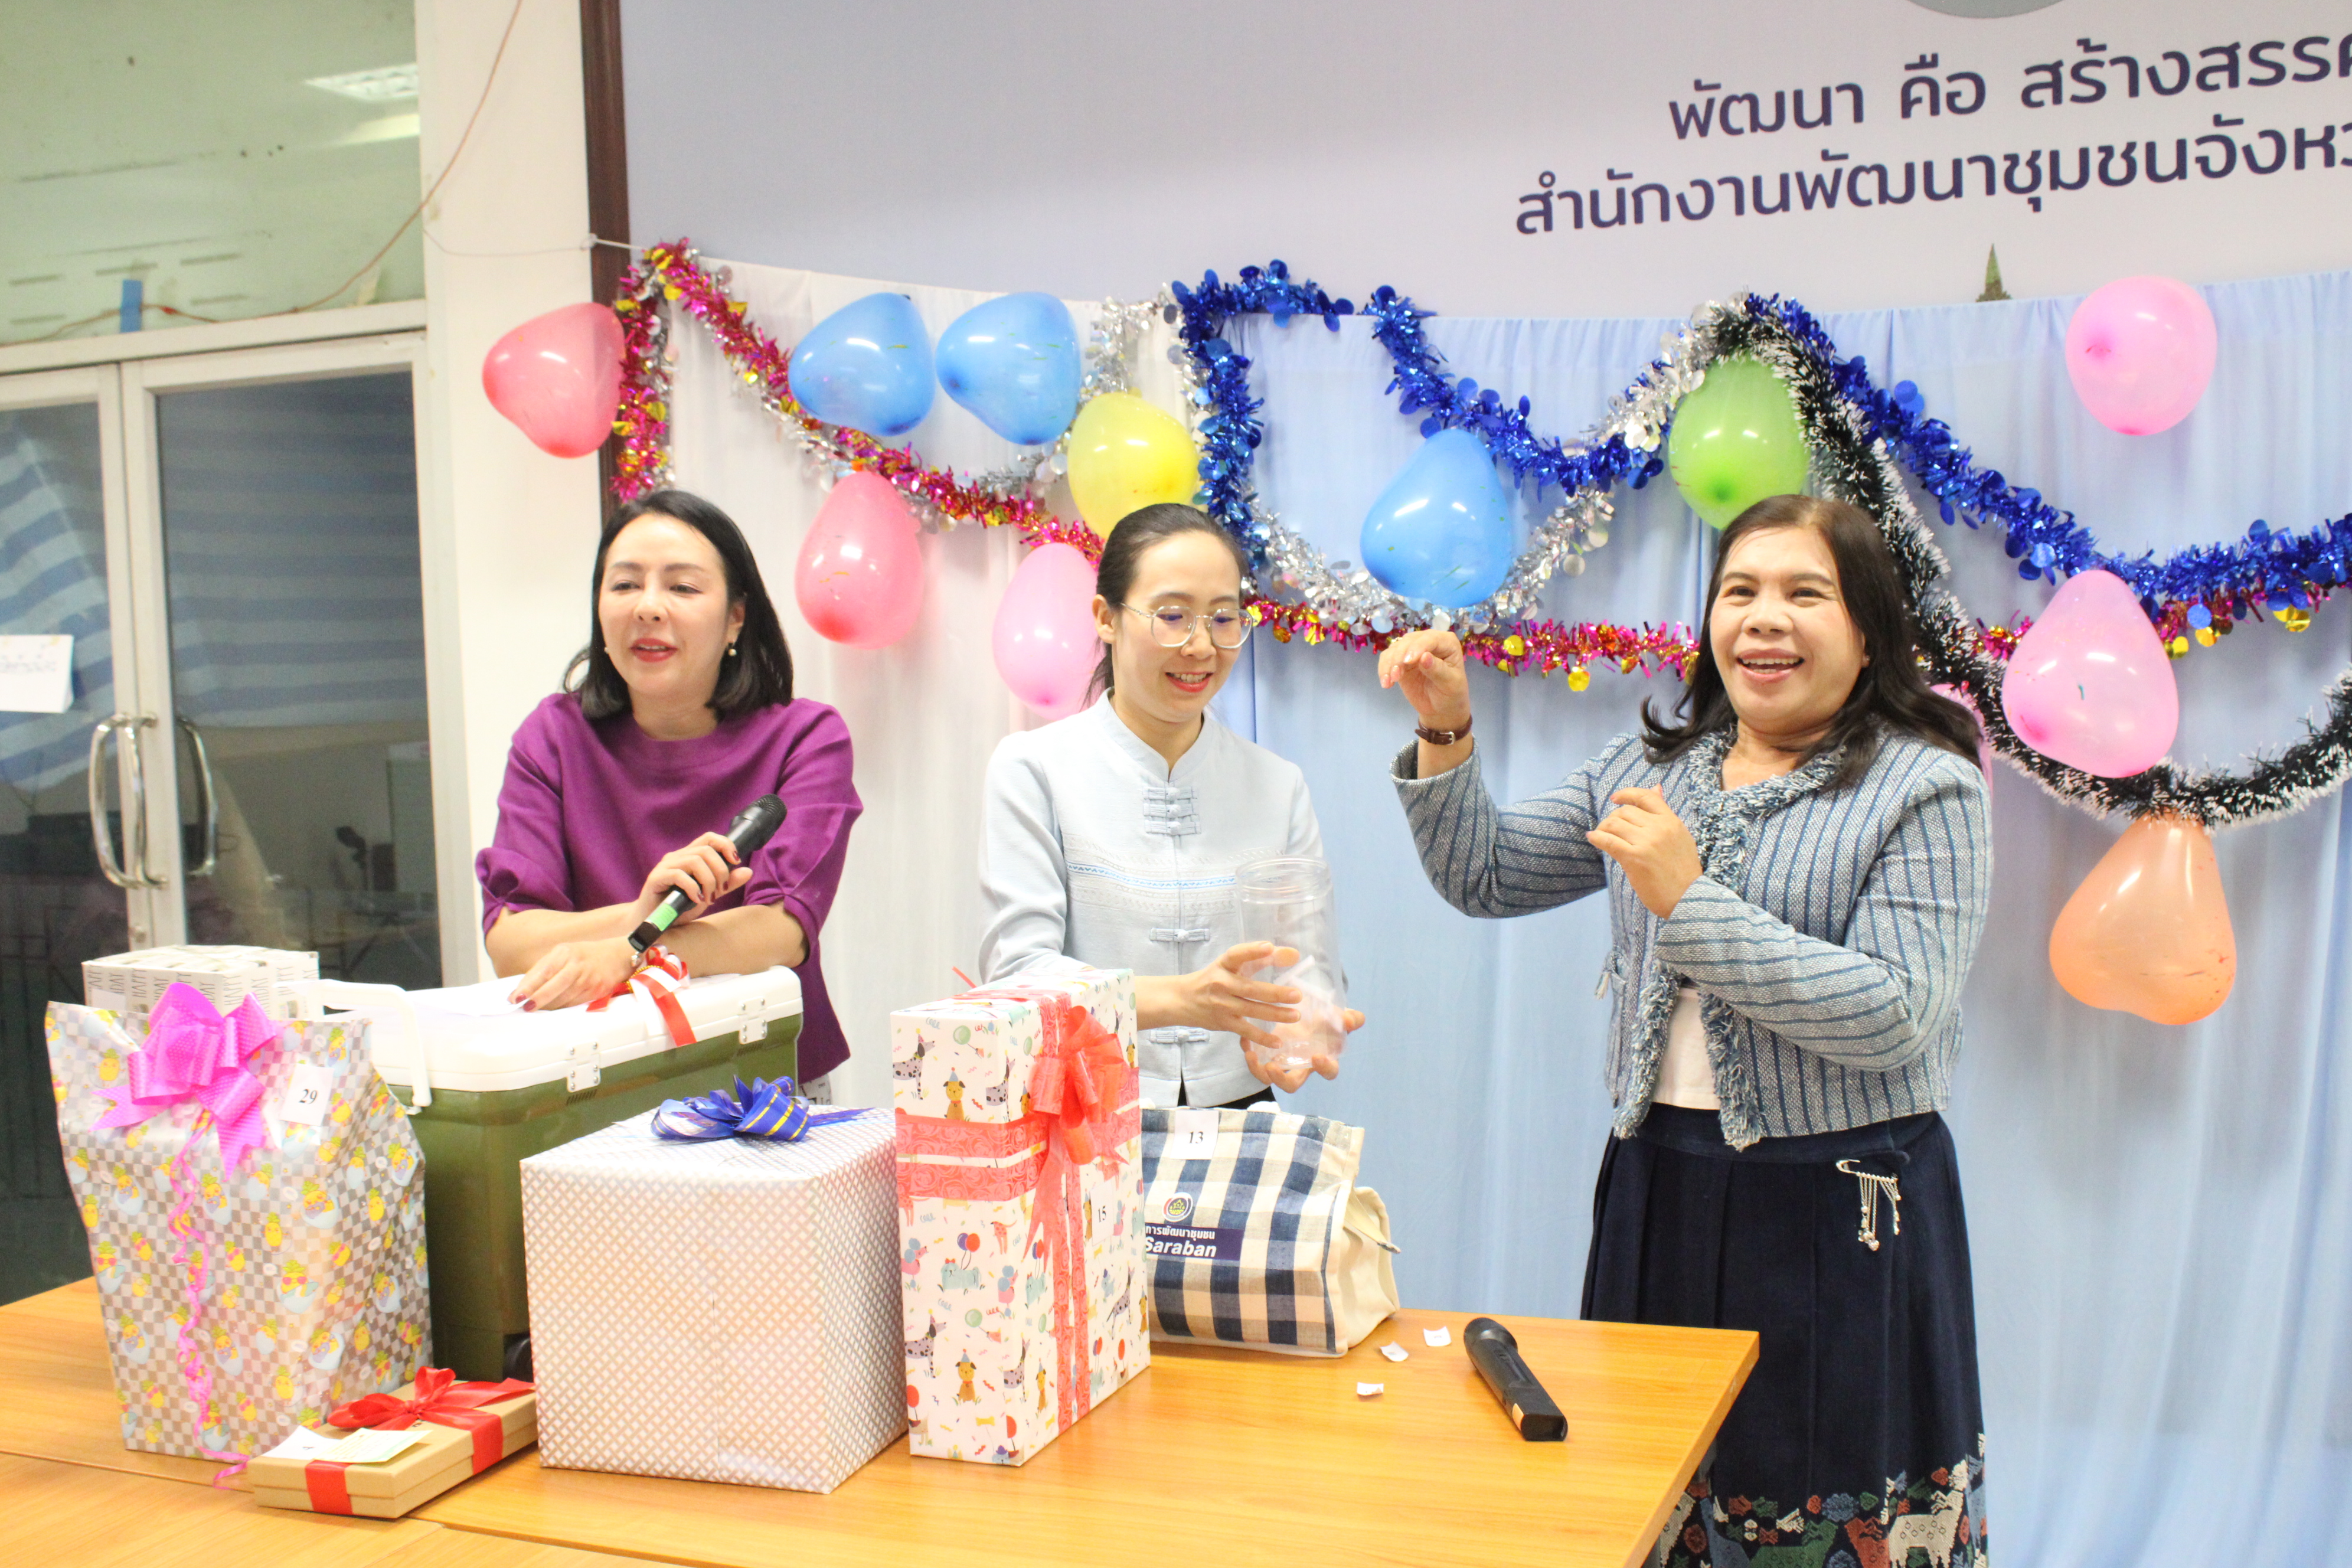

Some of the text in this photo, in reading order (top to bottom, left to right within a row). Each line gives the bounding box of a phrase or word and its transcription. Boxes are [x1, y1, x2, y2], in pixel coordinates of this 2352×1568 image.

[1668, 33, 2352, 140] พัฒนา คือ สร้างสรร
[1516, 113, 2352, 234] สำนักงานพัฒนาชุมชนจังห
[223, 975, 243, 1006] HAPPY
[298, 1089, 318, 1105] 29
[1188, 1131, 1204, 1144] 13
[1098, 1205, 1107, 1223] 15
[1145, 1236, 1217, 1257] Saraban
